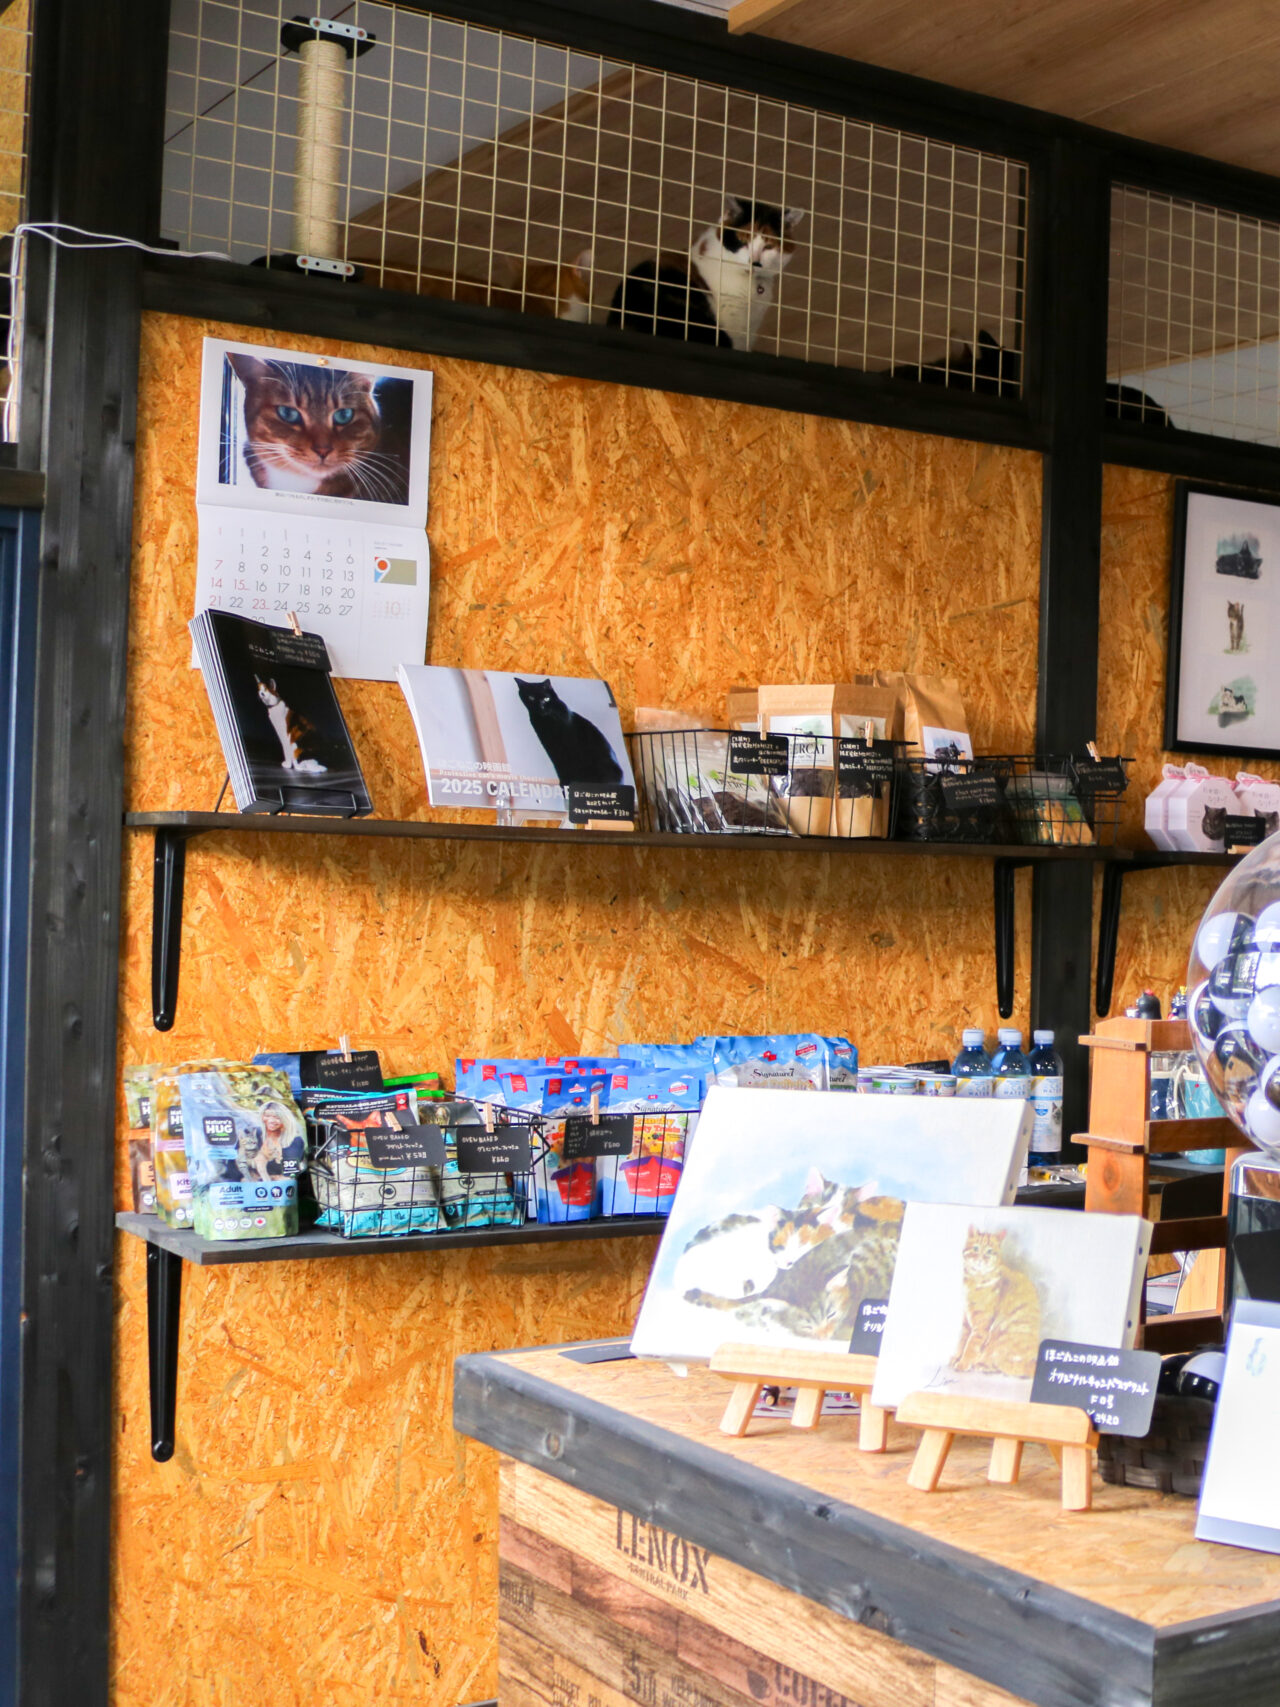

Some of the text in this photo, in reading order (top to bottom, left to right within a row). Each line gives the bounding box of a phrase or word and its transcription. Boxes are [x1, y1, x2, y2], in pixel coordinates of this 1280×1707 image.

[261, 545, 269, 557] 2
[283, 547, 290, 559] 3
[303, 550, 311, 560] 4
[326, 552, 333, 562] 5
[346, 554, 354, 564] 6
[215, 559, 354, 581] 7 8 9 10 11 12 13
[211, 577, 356, 599] 14 15 16 17 18 19 20
[209, 595, 353, 616] 21 22 23 24 25 26 27
[440, 778, 484, 795] 2025
[206, 1124, 233, 1134] HUG
[219, 1185, 243, 1193] Adult
[616, 1507, 711, 1595] LENOX
